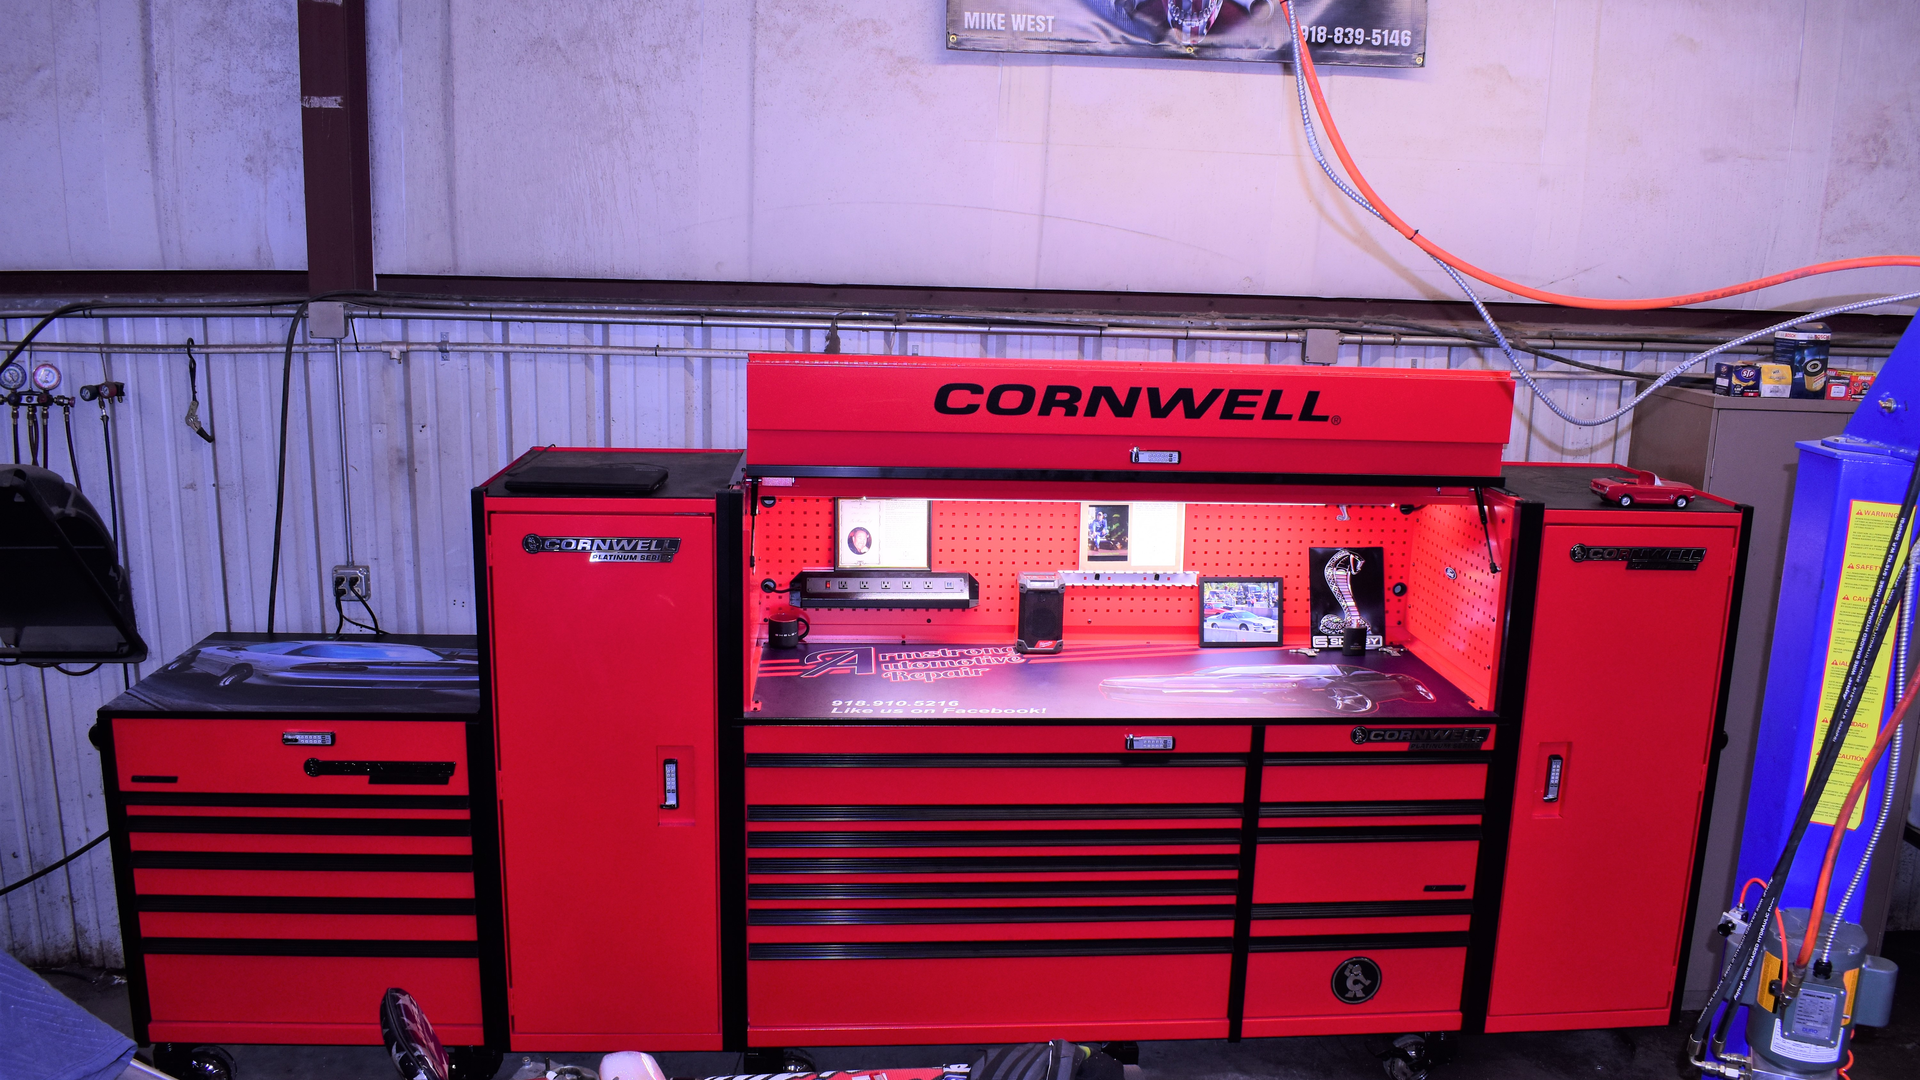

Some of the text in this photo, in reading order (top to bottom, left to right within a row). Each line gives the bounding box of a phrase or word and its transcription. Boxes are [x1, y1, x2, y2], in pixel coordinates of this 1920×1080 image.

[964, 11, 1055, 33] MIKE WEST
[1300, 25, 1412, 47] 918-839-5146
[1741, 369, 1756, 379] STP
[934, 382, 1330, 423] CORNWELL
[1864, 509, 1899, 519] WARNING
[543, 538, 676, 551] CORNWELL
[1588, 547, 1704, 563] CORNWELL
[1850, 659, 1859, 675] WIRE
[1855, 632, 1868, 659] BRAIDED
[1863, 597, 1879, 632] HYDRAULIC
[1874, 579, 1885, 597] HOSE
[882, 667, 991, 682] Repair
[1369, 730, 1484, 742] CORNWELL
[1741, 966, 1751, 980] WIRE
[1746, 942, 1760, 966] BRAIDED
[1754, 912, 1771, 943] HYDRAULIC
